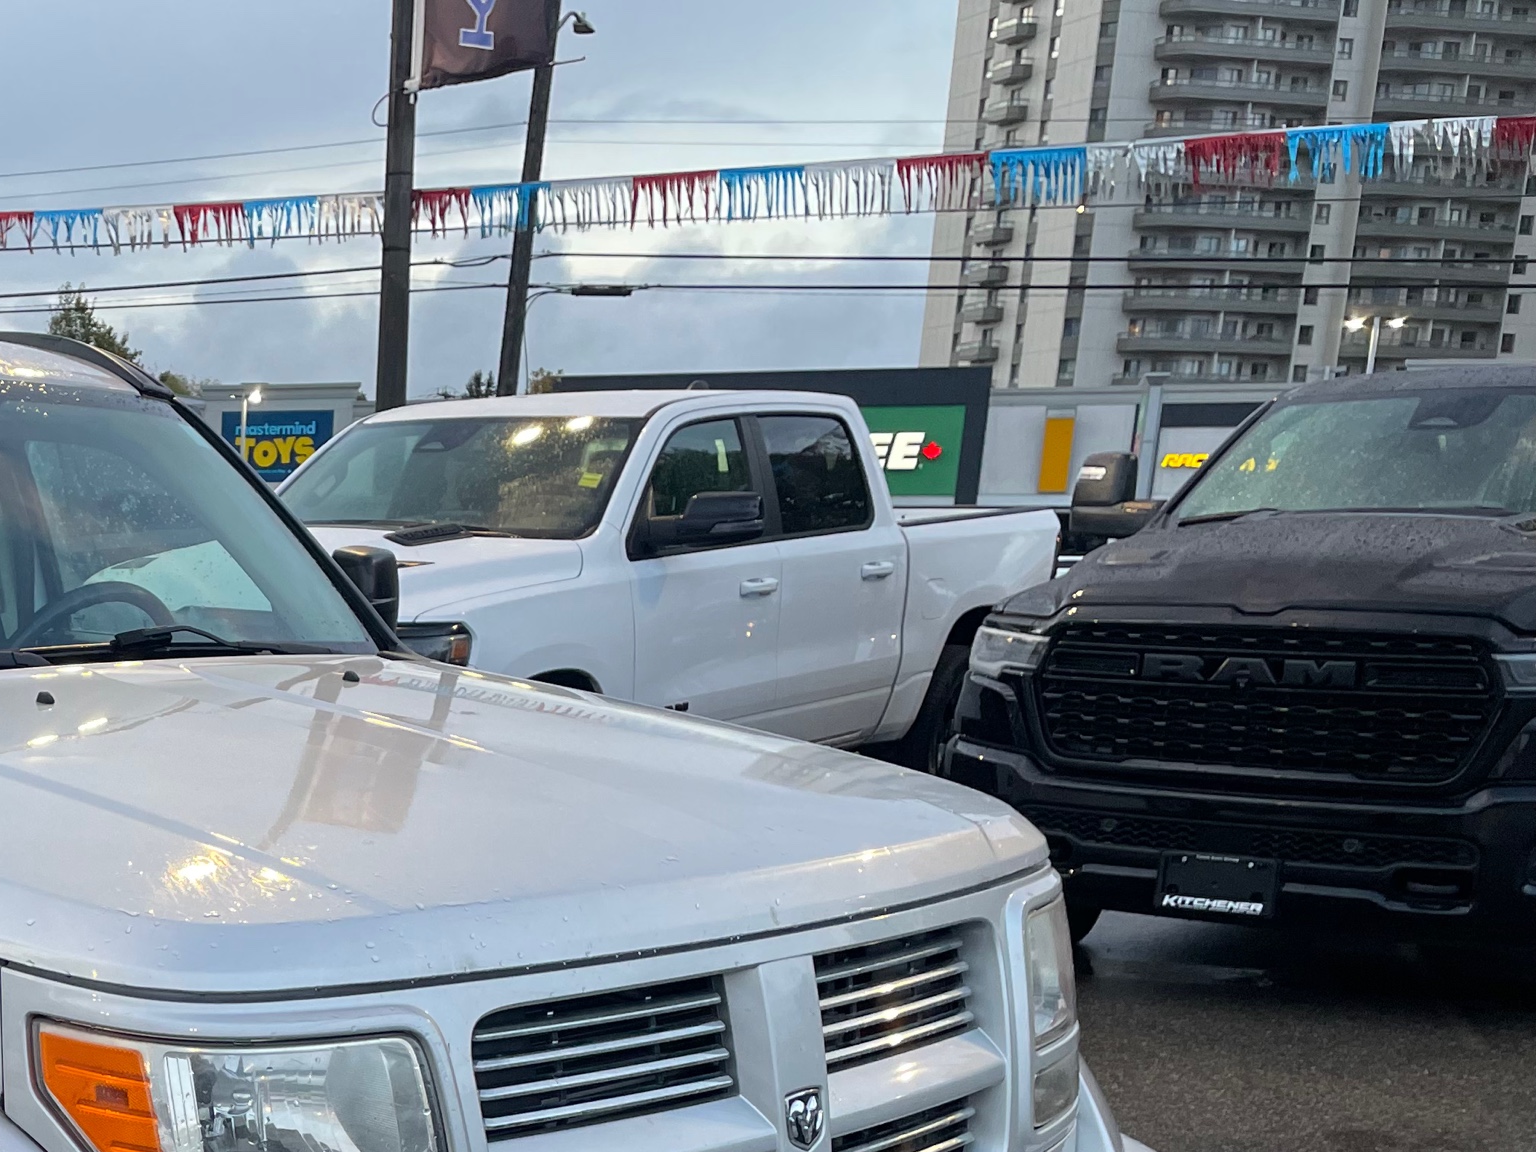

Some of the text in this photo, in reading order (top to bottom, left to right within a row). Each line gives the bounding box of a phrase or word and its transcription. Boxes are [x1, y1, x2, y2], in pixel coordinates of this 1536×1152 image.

[235, 421, 316, 435] mastermind
[234, 436, 315, 468] TOYS
[1142, 653, 1357, 687] RAM
[1162, 894, 1264, 913] KITCHENER
